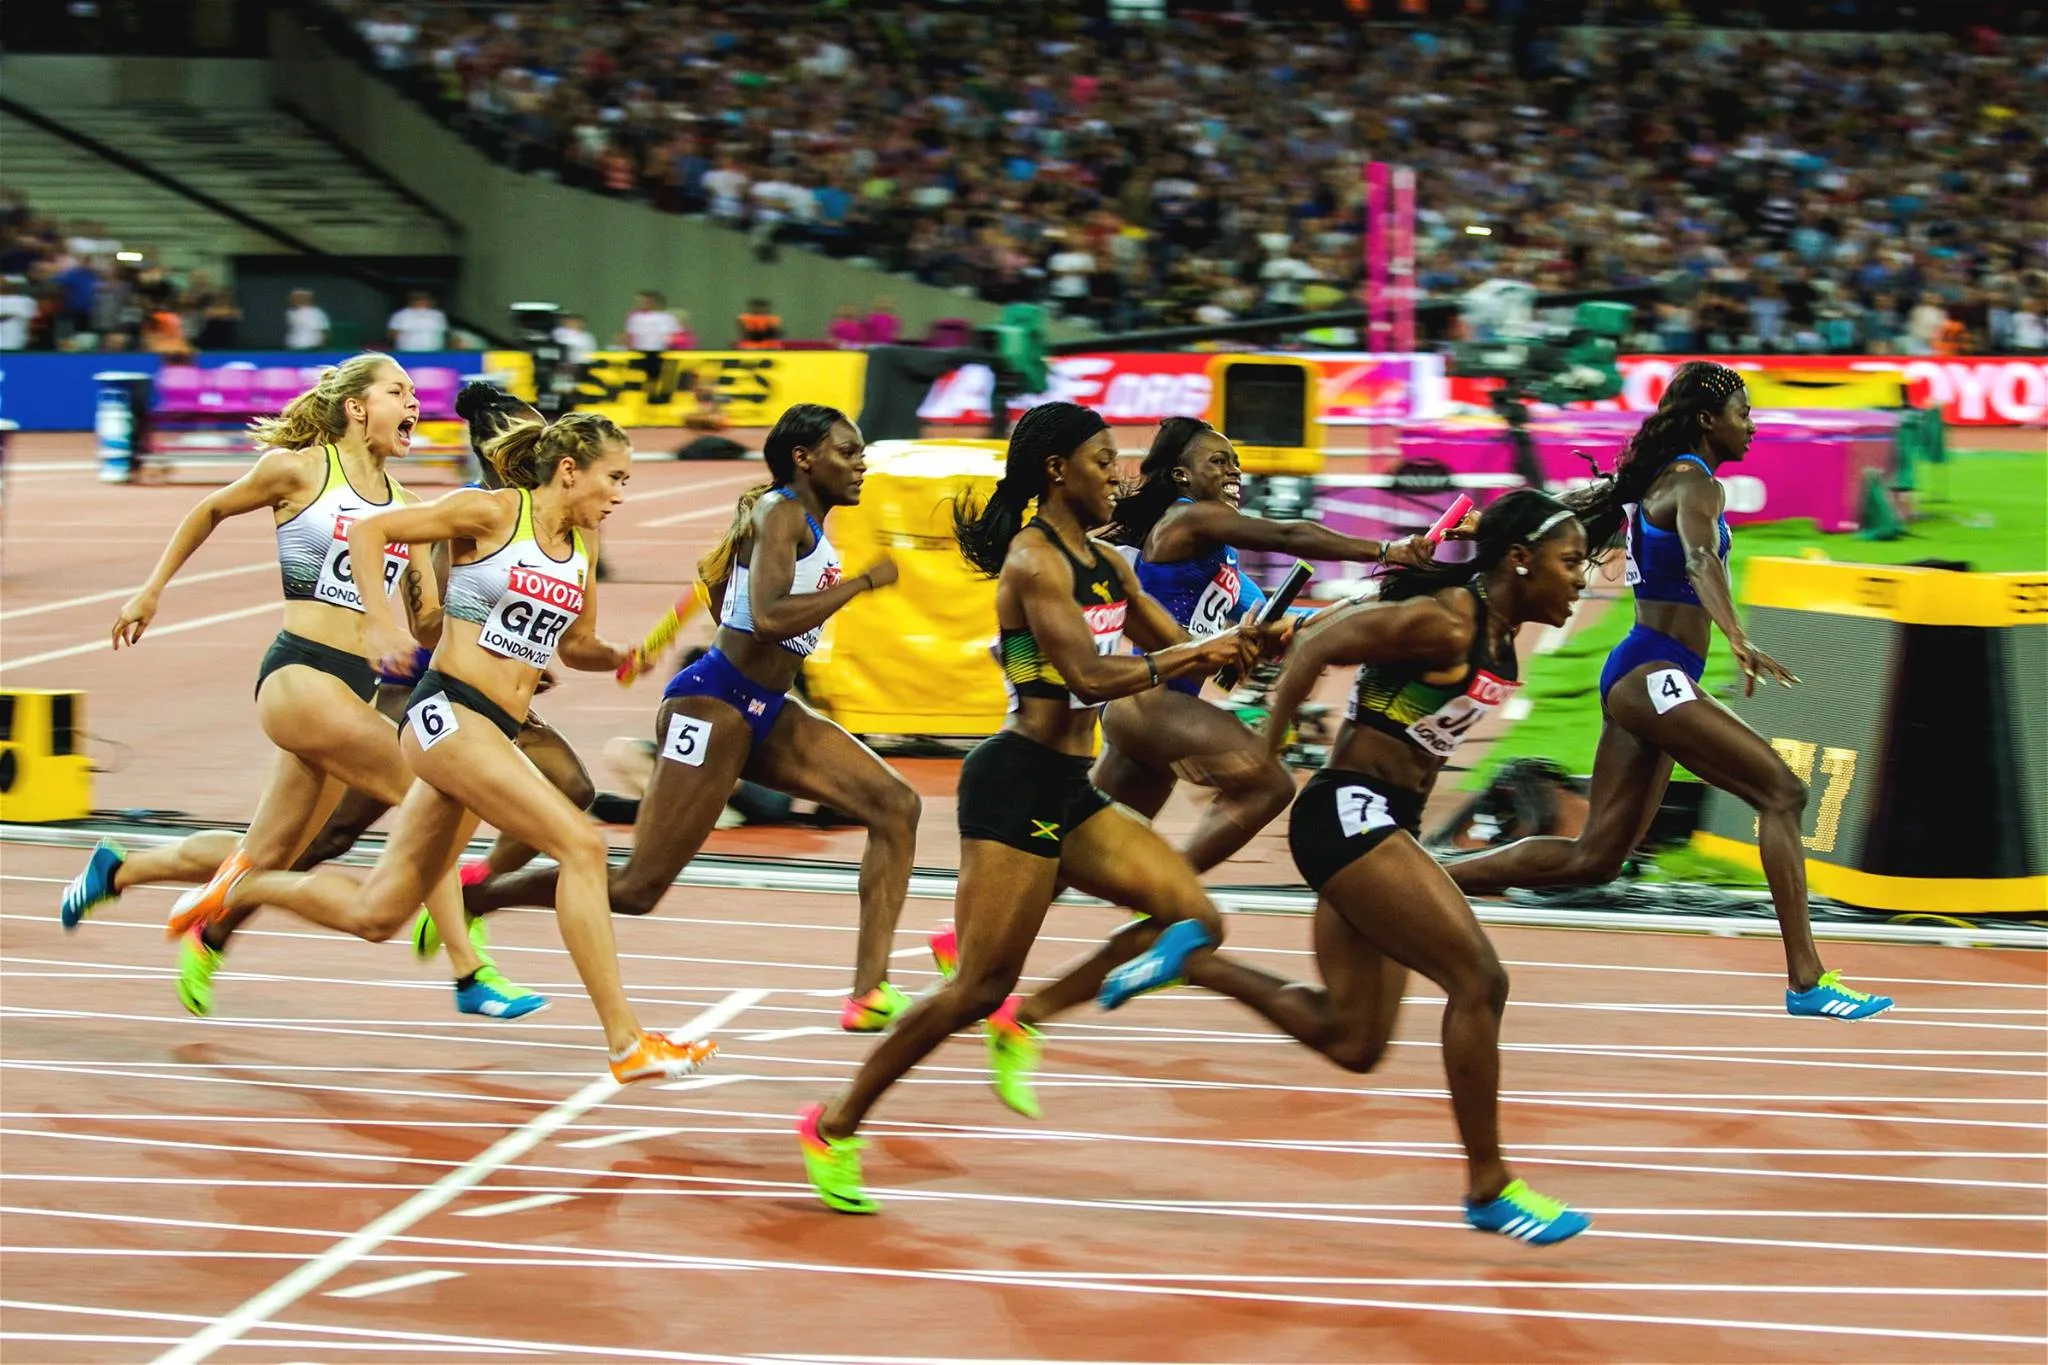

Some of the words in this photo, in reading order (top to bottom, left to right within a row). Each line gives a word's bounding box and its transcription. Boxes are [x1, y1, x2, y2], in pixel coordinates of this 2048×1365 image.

[332, 549, 399, 595] GR
[511, 570, 584, 611] TOYOTA
[500, 600, 568, 648] GER
[1661, 674, 1682, 699] 4
[421, 703, 444, 736] 6
[675, 723, 700, 756] 5
[1351, 793, 1374, 822] 7
